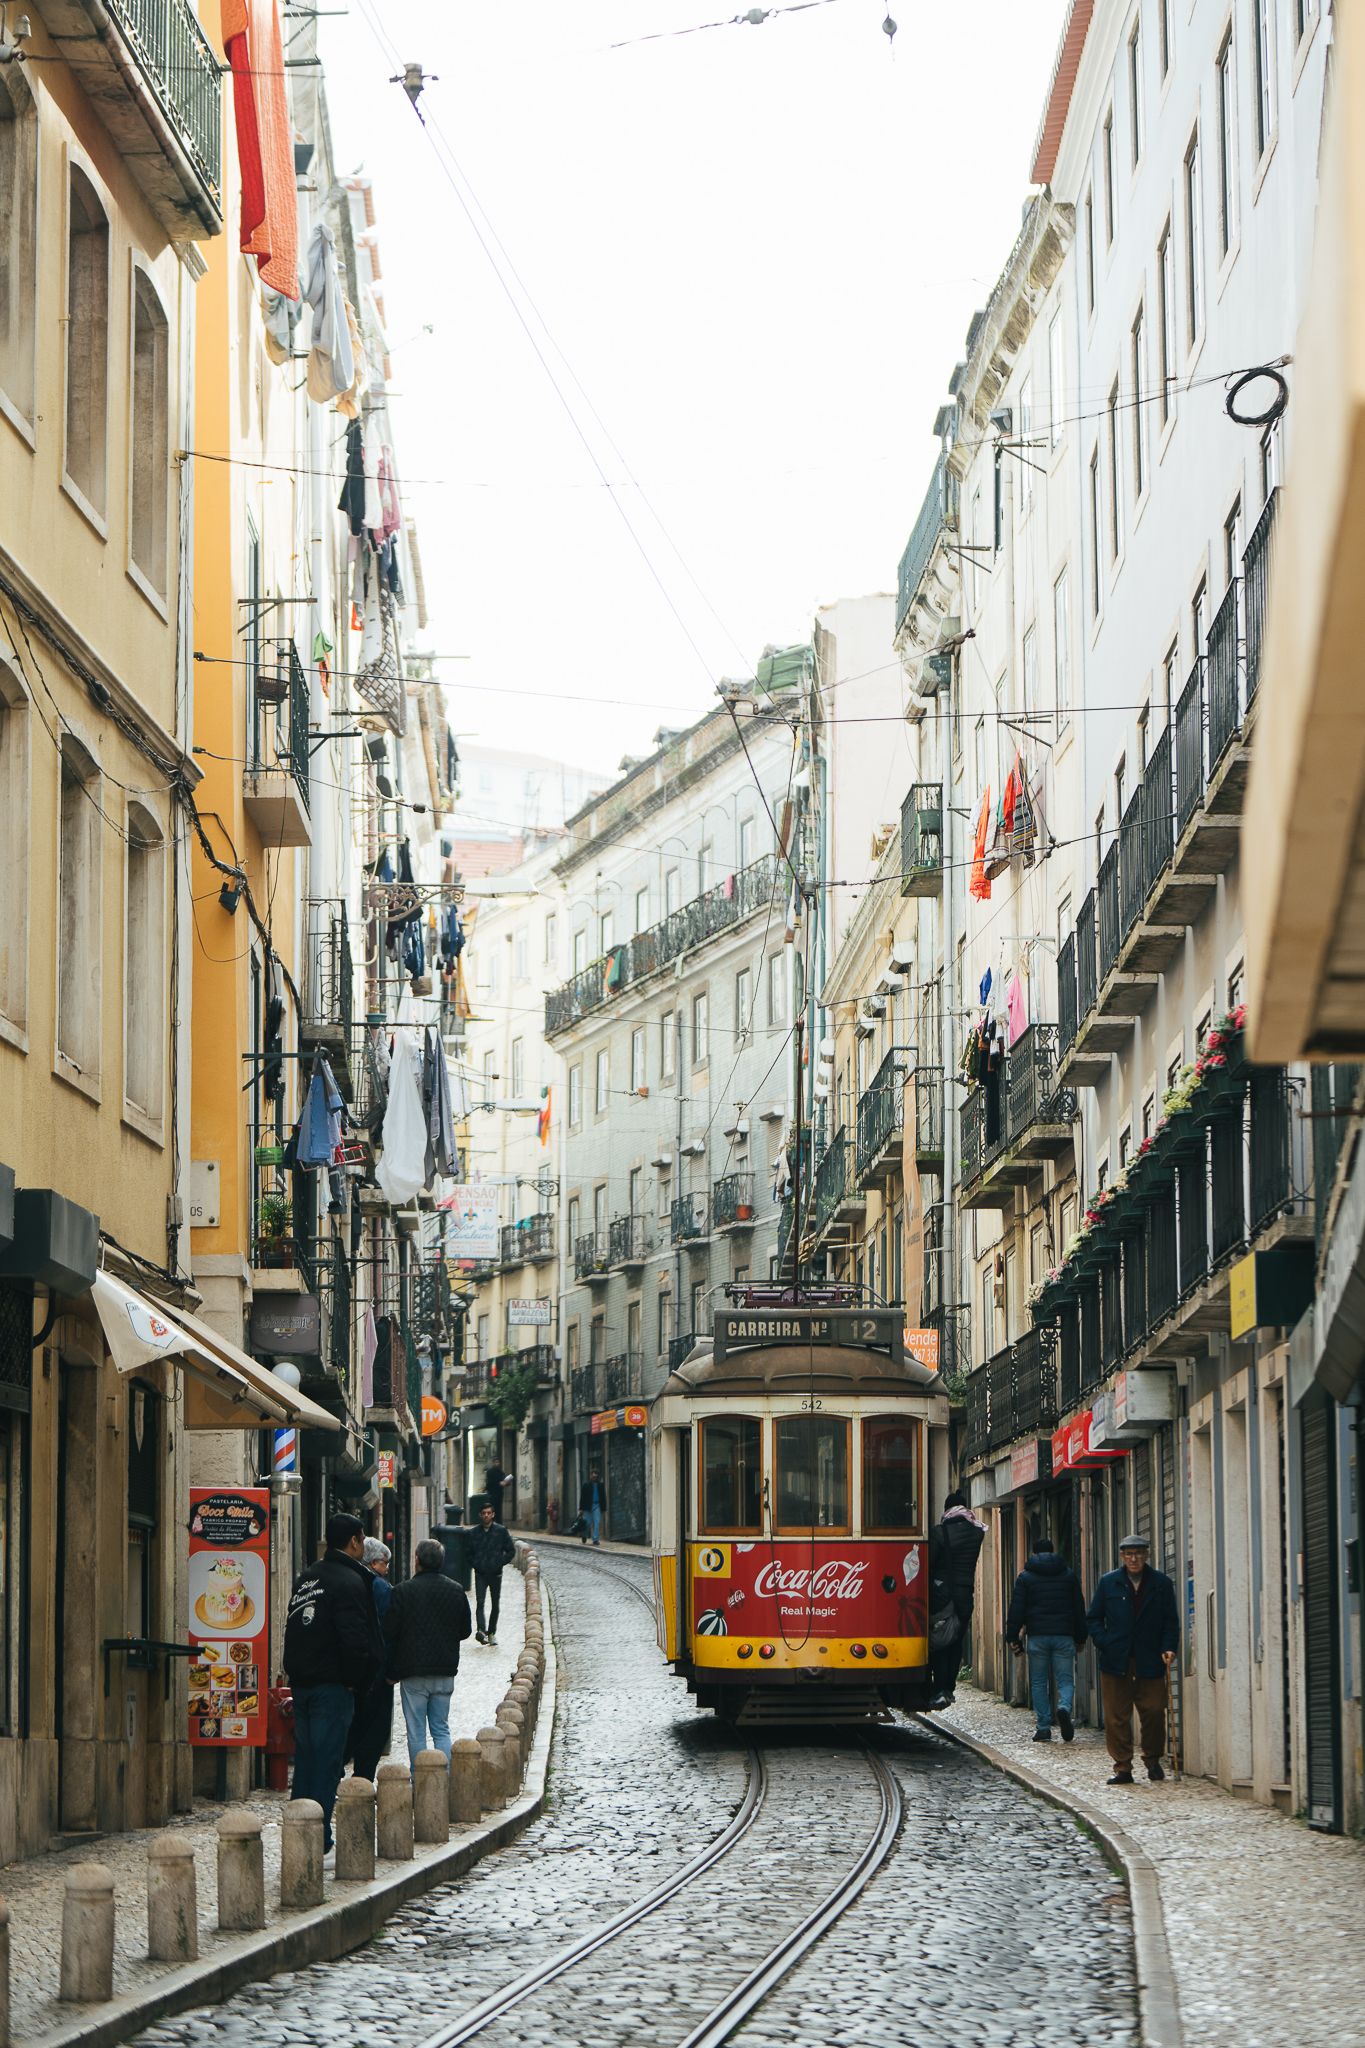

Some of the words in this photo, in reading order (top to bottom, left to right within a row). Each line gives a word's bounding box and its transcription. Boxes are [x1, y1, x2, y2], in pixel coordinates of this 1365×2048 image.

[511, 1300, 548, 1309] MALAS
[727, 1321, 801, 1337] CARREIRA
[811, 1321, 828, 1337] Nº
[850, 1319, 877, 1340] 12
[903, 1330, 937, 1346] Vende
[801, 1400, 822, 1410] 542
[754, 1560, 871, 1600] Coca-Cola
[780, 1606, 804, 1616] Real
[805, 1606, 836, 1618] Magic
